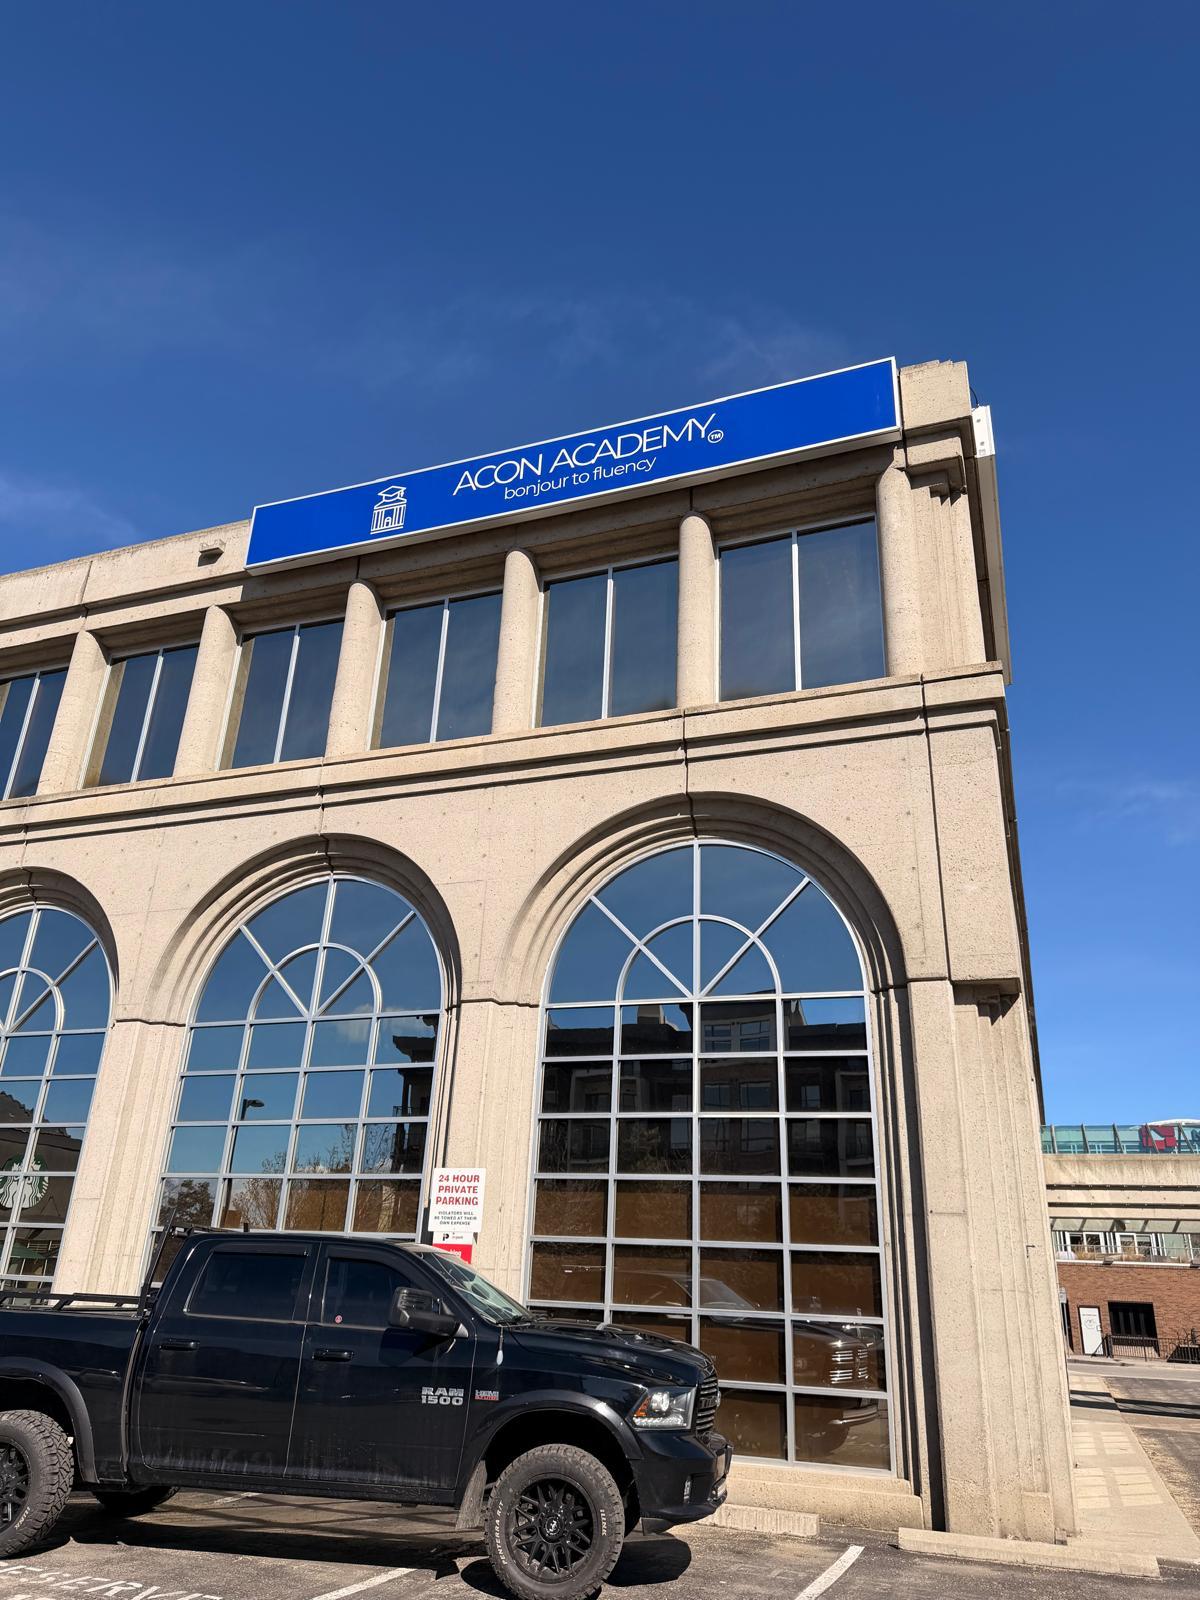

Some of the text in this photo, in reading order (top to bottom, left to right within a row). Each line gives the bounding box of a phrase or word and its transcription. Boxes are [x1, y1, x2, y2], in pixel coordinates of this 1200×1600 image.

[453, 453, 543, 496] ACON
[550, 413, 716, 473] ACADEMY
[504, 457, 657, 500] bonjour to fluency
[438, 1174, 480, 1183] 24 HOUR
[438, 1185, 479, 1194] PRIVATE
[435, 1196, 479, 1206] PARKING
[421, 1386, 464, 1397] RAM
[475, 1389, 499, 1400] HEMI
[421, 1395, 464, 1406] 1500
[495, 1499, 508, 1565] PENTERRA R/T
